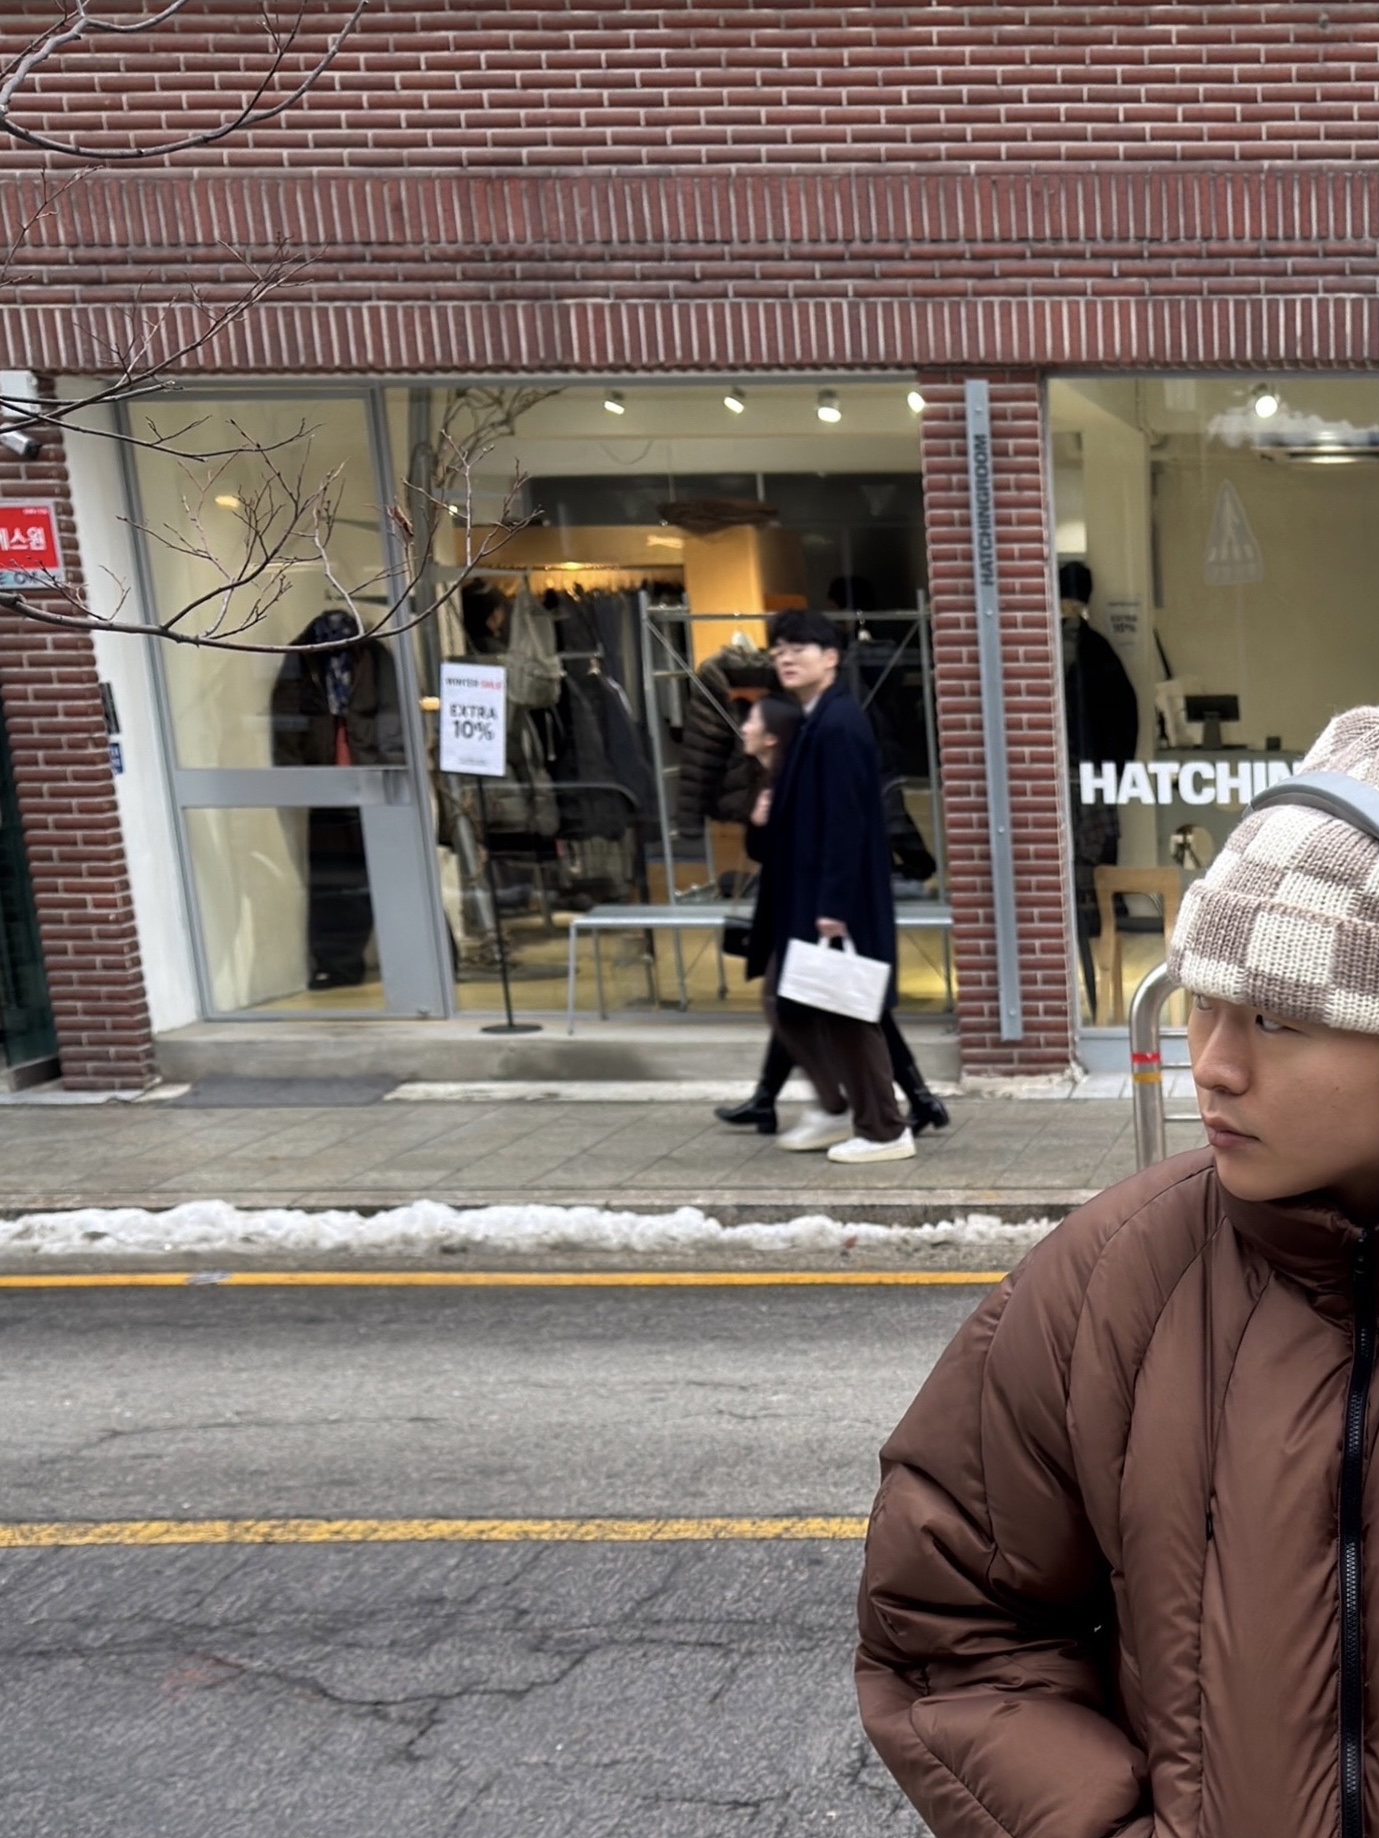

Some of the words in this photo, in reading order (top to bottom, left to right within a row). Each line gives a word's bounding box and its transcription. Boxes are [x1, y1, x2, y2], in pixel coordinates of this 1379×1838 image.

[974, 433, 995, 586] HATCHINGROOM
[450, 704, 497, 719] EXTRA
[454, 720, 494, 740] 10%
